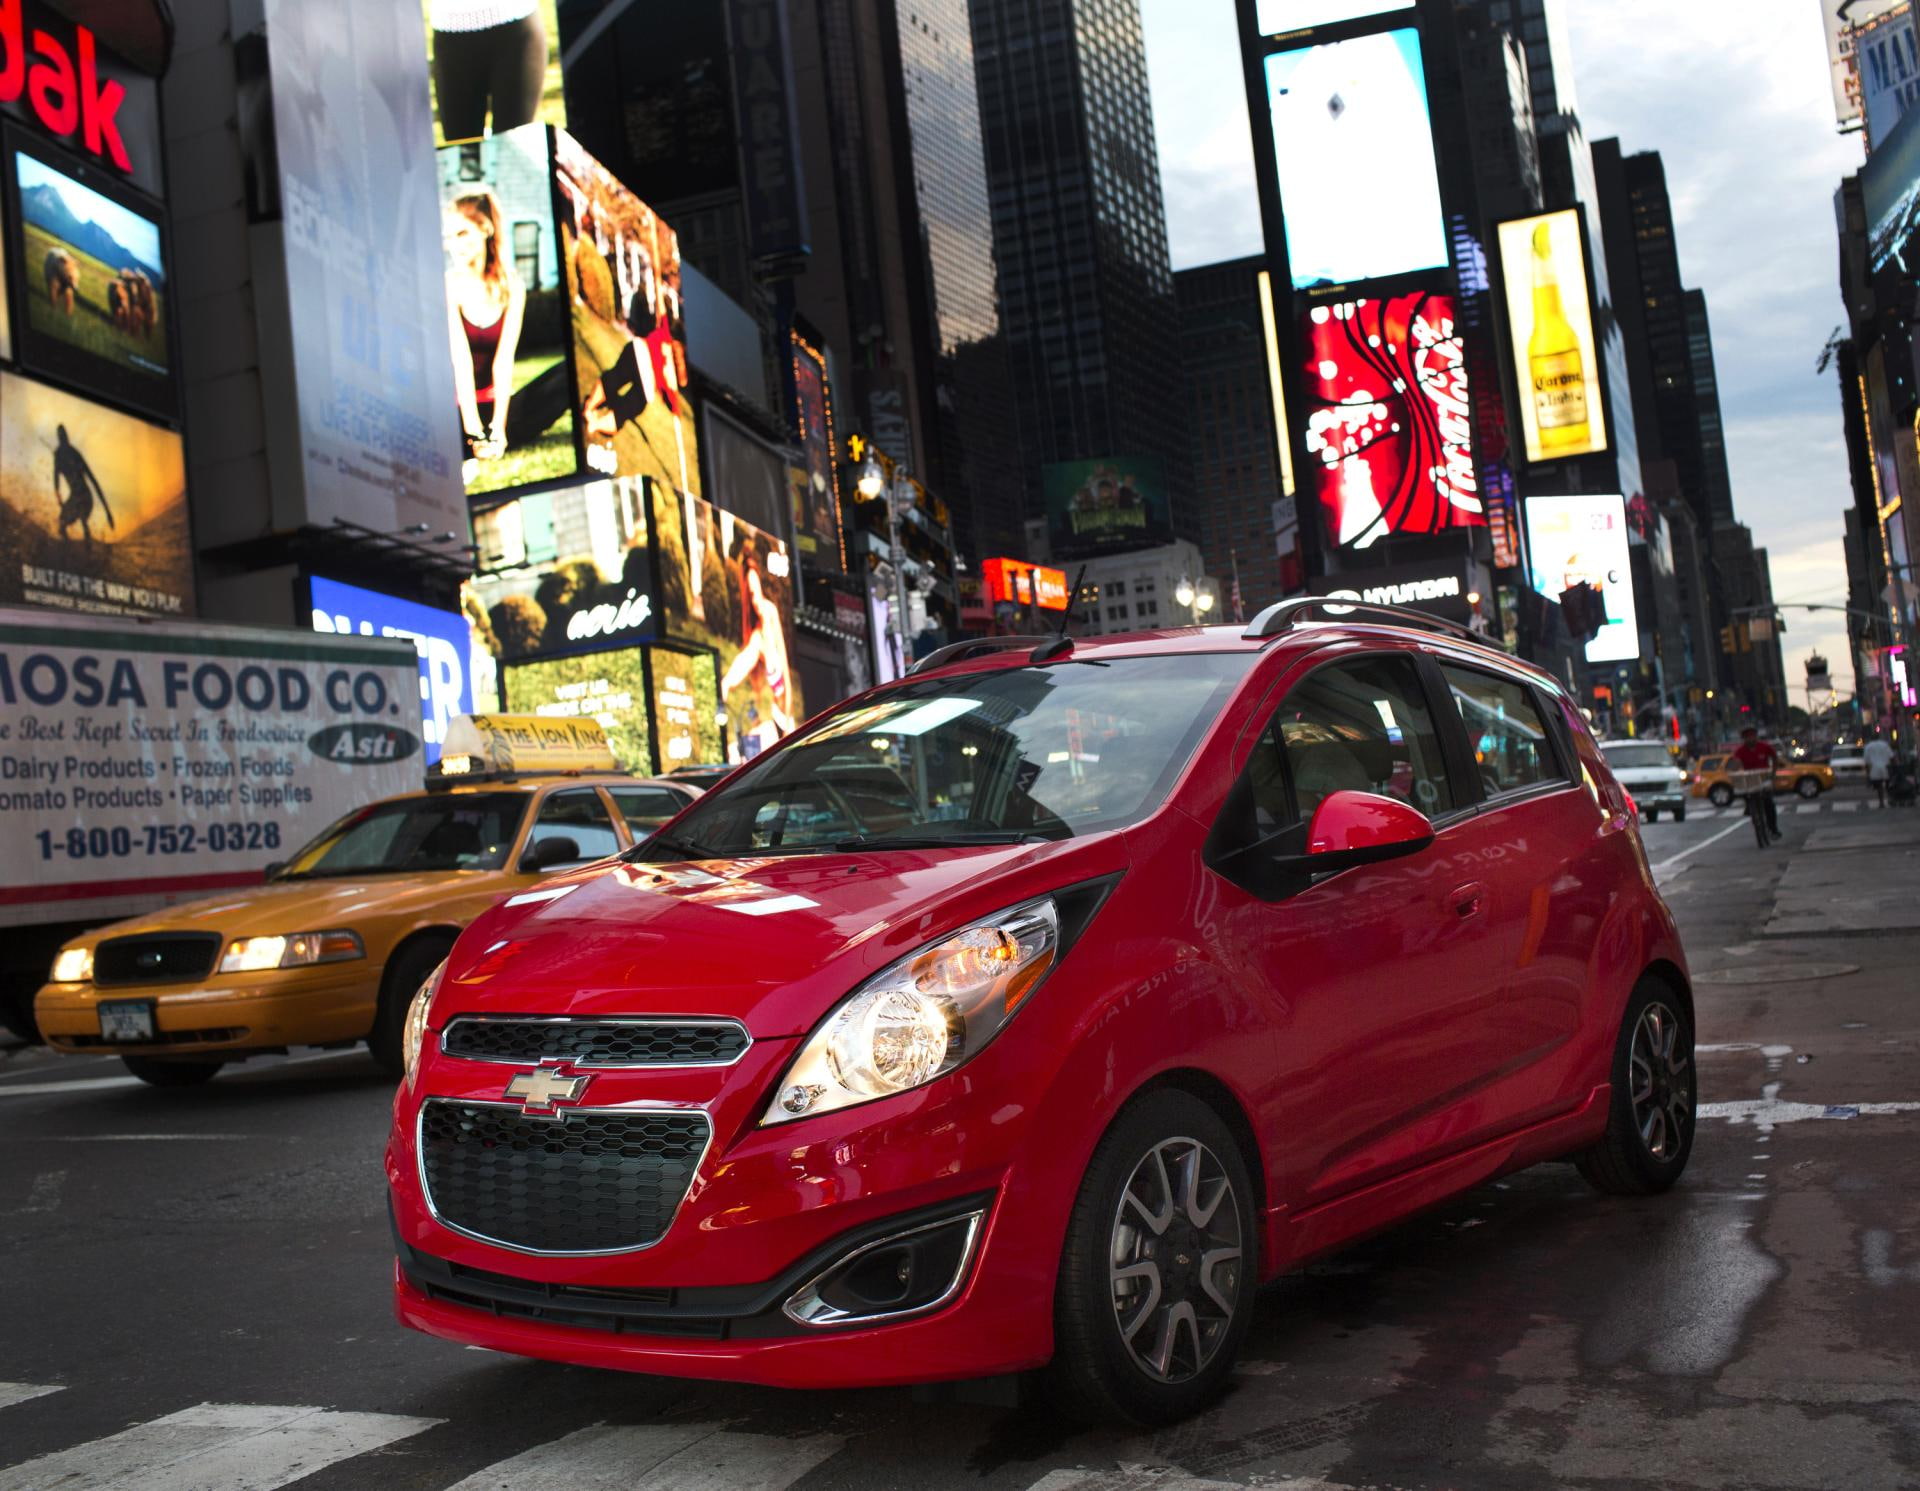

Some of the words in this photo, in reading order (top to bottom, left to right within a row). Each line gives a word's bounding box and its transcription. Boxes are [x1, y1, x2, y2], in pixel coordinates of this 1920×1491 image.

[1363, 576, 1460, 605] HYUNDAI
[162, 660, 311, 712] FOOD
[324, 670, 400, 716] CO.
[18, 715, 65, 741] Best
[72, 716, 122, 749] Kept
[130, 720, 181, 743] Secret
[187, 721, 209, 743] In
[216, 719, 307, 744] Foodservice
[329, 729, 397, 758] Asti
[504, 727, 532, 744] THE
[2, 756, 58, 783] Dairy
[65, 756, 155, 779] Products
[173, 756, 236, 778] Frozen
[240, 755, 294, 778] Foods
[73, 785, 163, 809] Products
[181, 785, 232, 808] Paper
[238, 783, 313, 808] Supplies
[36, 821, 281, 860] 1-800-752-0328
